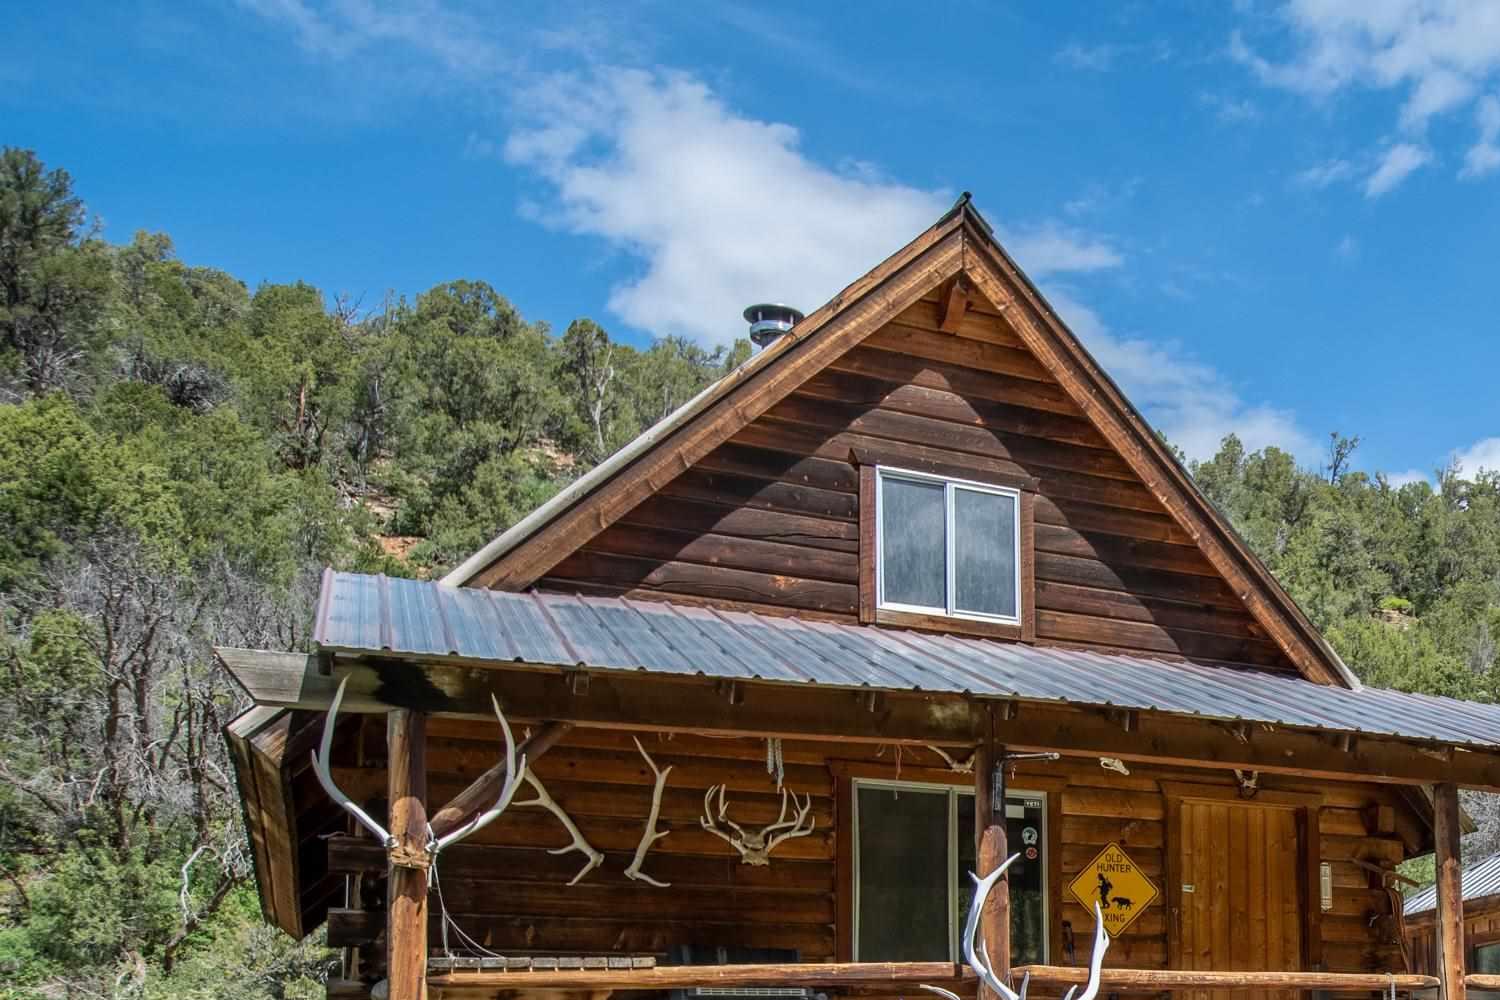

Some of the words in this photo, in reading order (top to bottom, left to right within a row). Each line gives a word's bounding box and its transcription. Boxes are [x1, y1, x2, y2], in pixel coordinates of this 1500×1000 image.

[1105, 854, 1122, 863] OLD
[1097, 864, 1131, 872] HUNTER
[1104, 913, 1125, 922] XING
